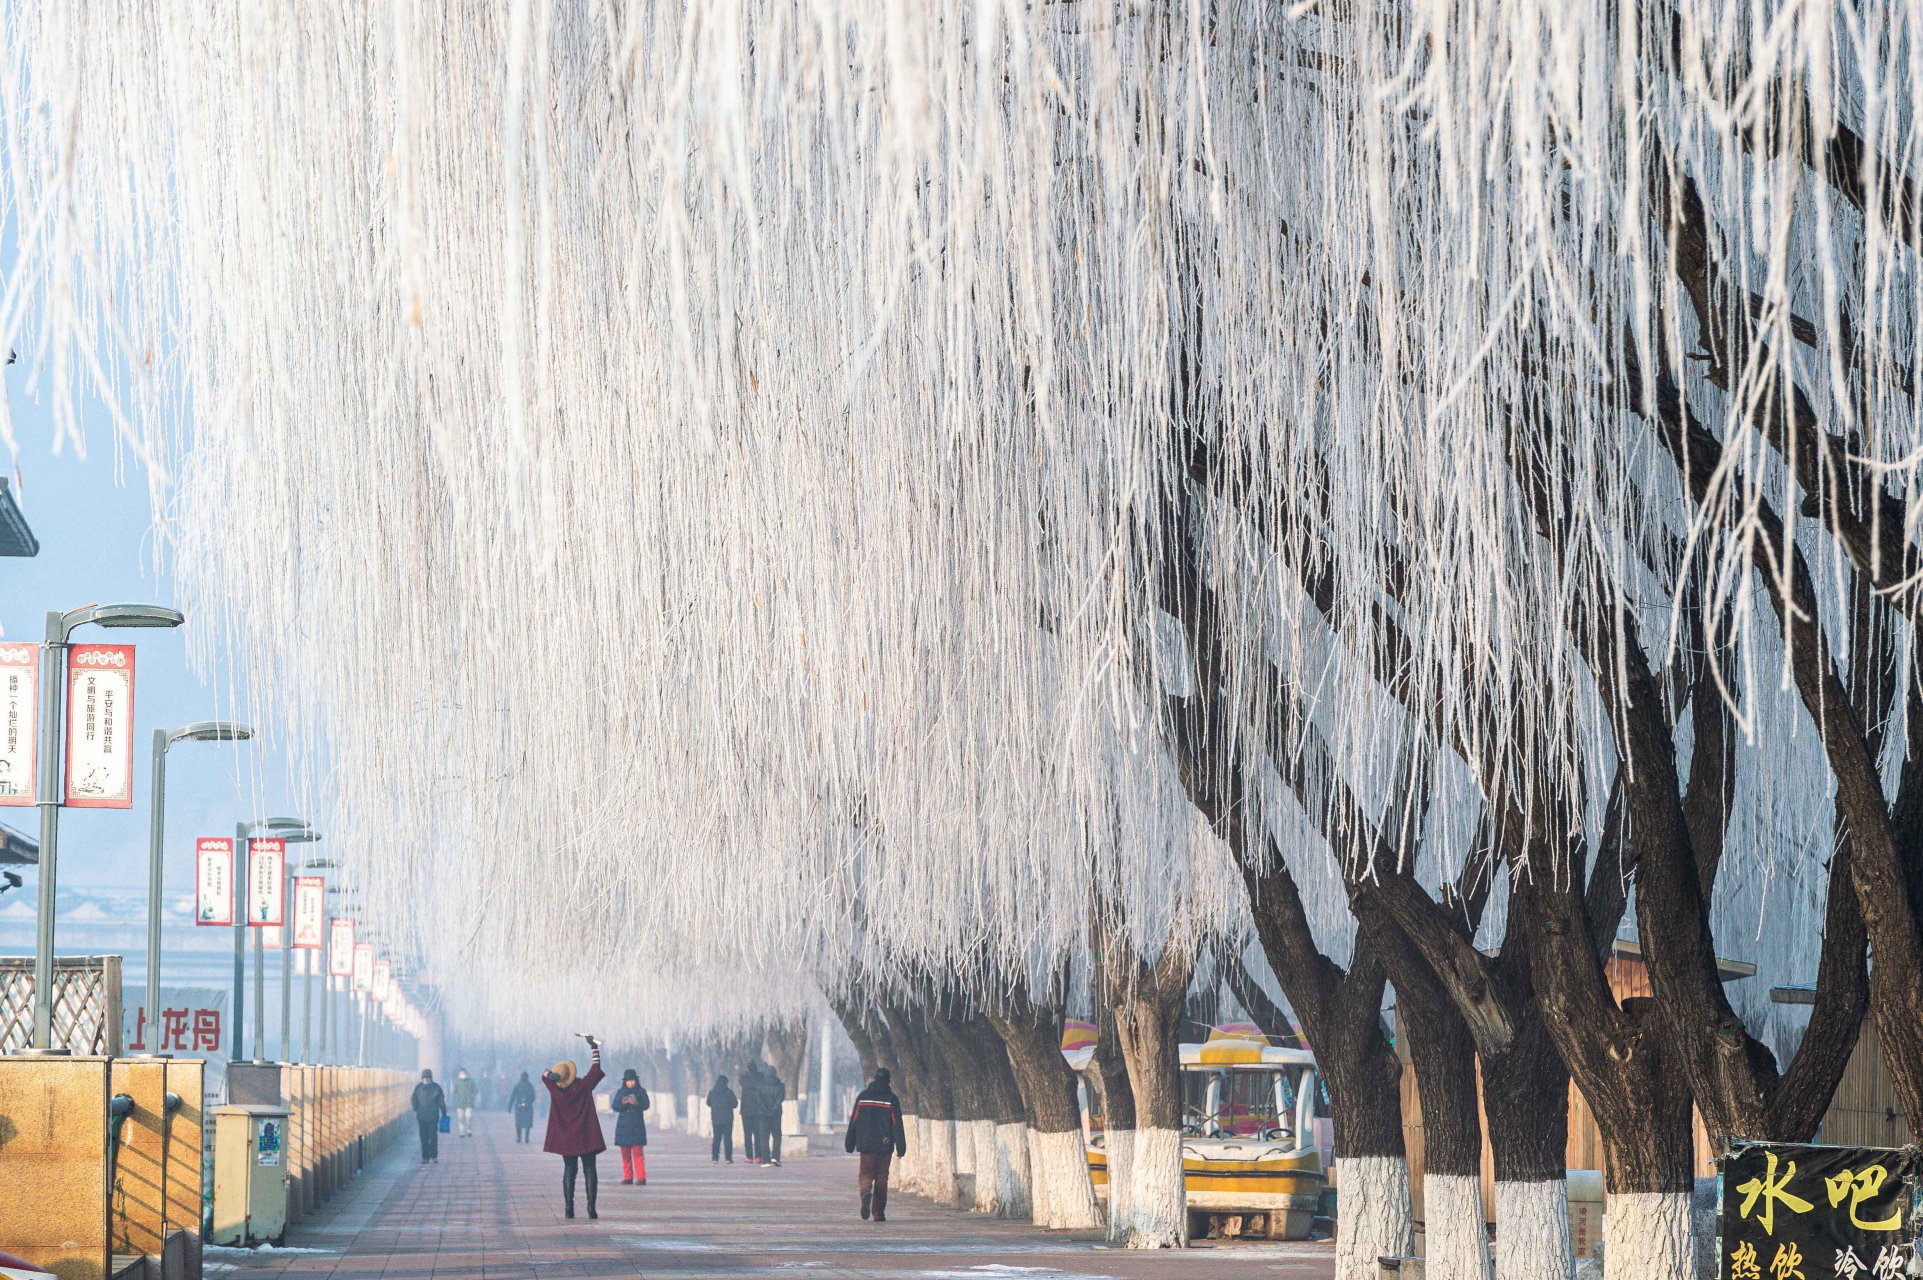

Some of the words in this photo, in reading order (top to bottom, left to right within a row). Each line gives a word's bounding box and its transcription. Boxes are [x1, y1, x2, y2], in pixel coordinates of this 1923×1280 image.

[7, 675, 18, 754] 播种一个灿烂的明天
[86, 676, 96, 741] 文明与旅游同行
[103, 690, 114, 754] 平安与和谐共赢
[123, 1006, 221, 1052] 上龙舟
[1735, 1150, 1902, 1236] 水吧
[1577, 1207, 1587, 1256] 凌河是我家
[1730, 1240, 1806, 1280] 热饮
[1834, 1244, 1906, 1280] 冷饮
